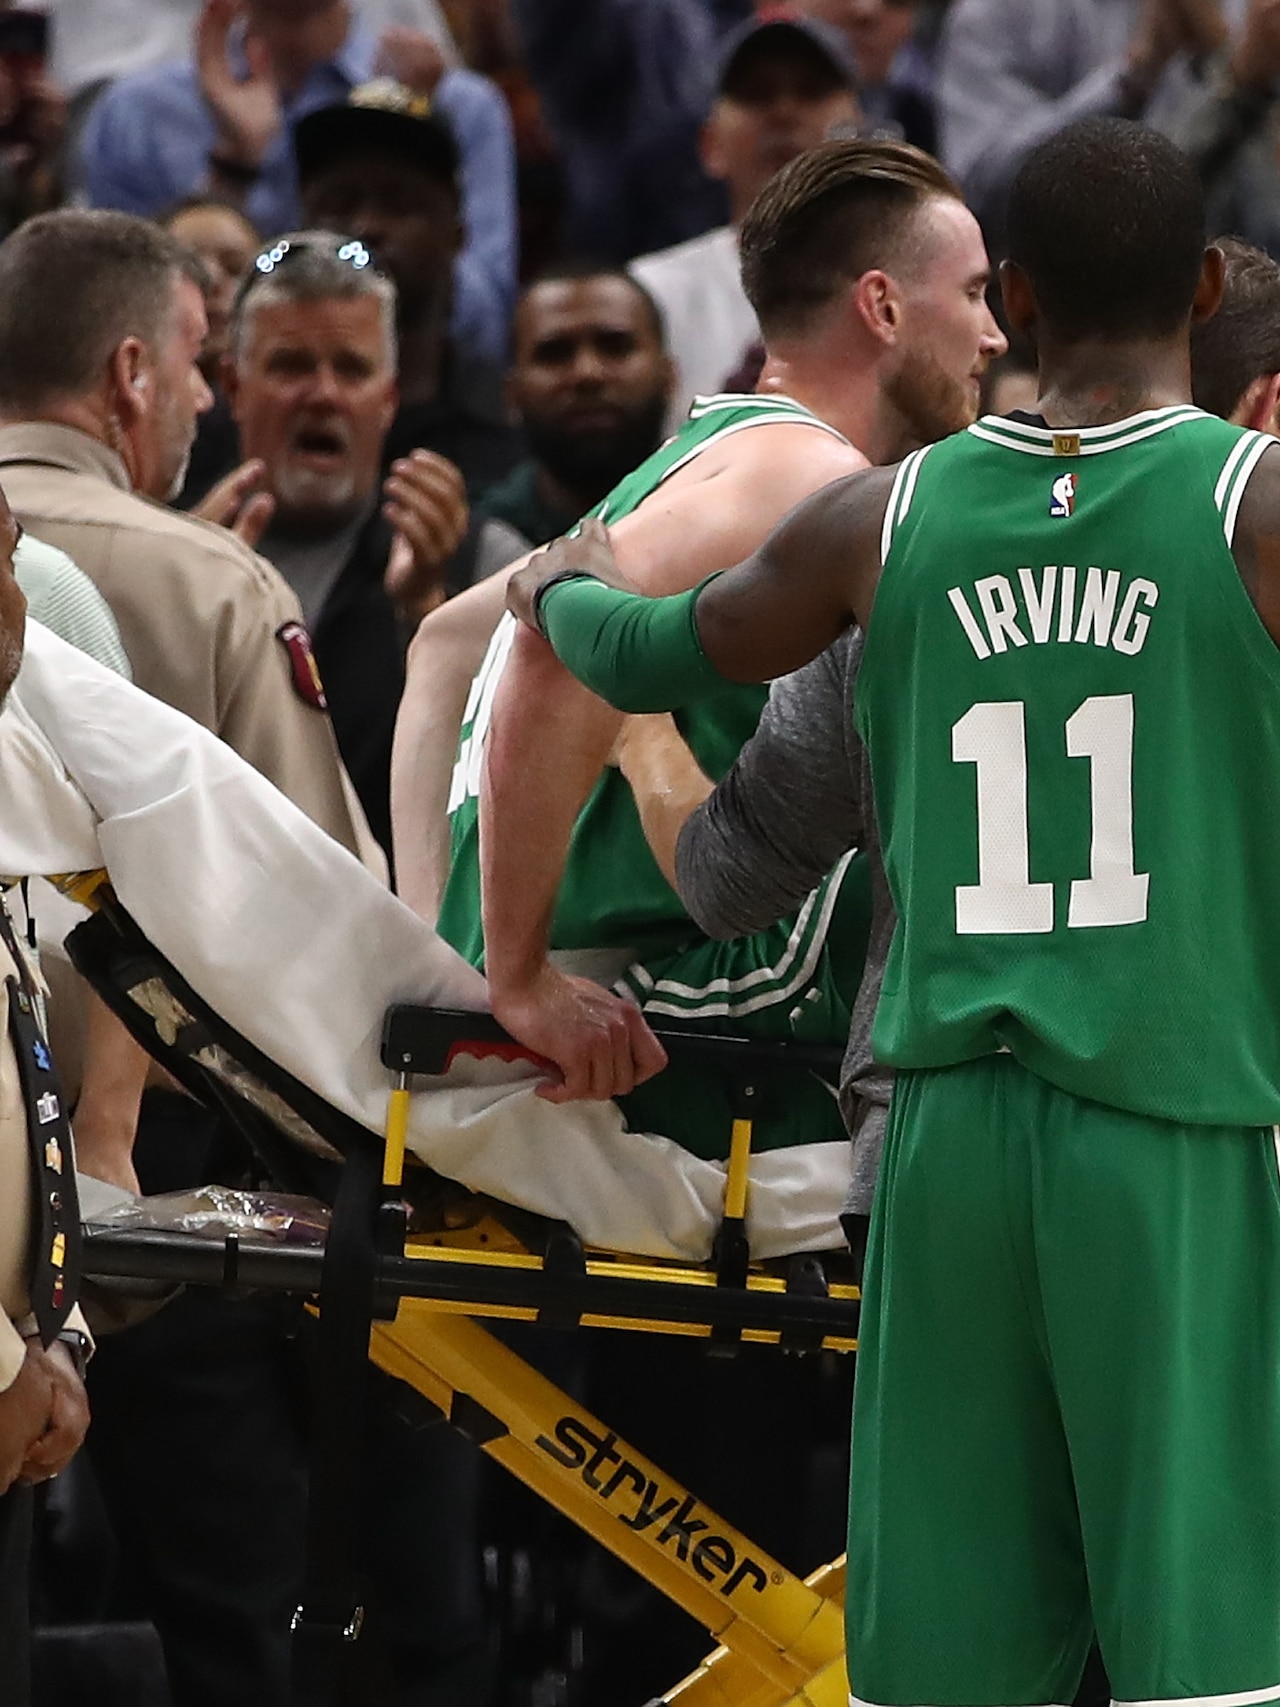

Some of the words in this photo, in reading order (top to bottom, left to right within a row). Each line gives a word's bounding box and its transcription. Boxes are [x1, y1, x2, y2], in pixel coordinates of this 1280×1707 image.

[947, 566, 1158, 660] IRVING
[952, 693, 1150, 934] 11
[535, 1416, 768, 1597] stryker
